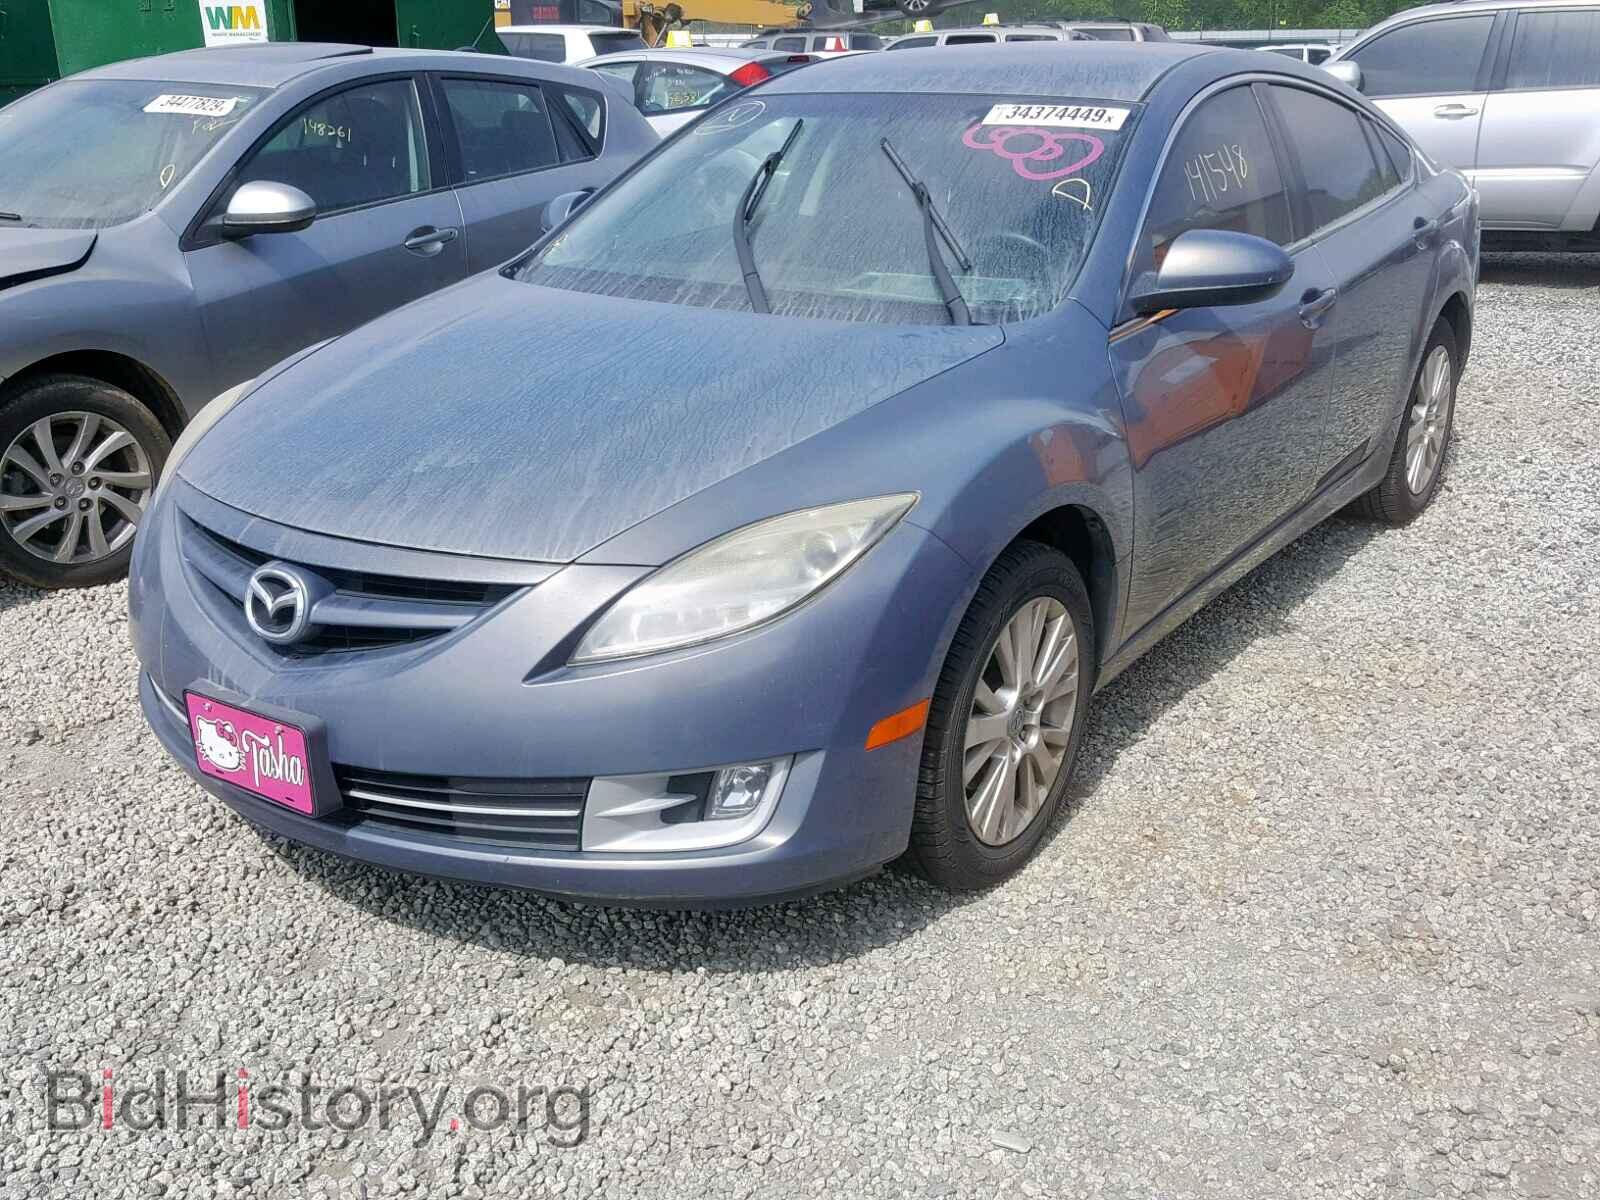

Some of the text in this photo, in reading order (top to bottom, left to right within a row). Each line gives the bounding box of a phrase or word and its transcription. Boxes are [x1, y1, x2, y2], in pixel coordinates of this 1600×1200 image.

[205, 6, 260, 30] WM
[303, 117, 351, 143] 148261
[1184, 143, 1248, 202] 141548
[241, 729, 304, 788] Tasha
